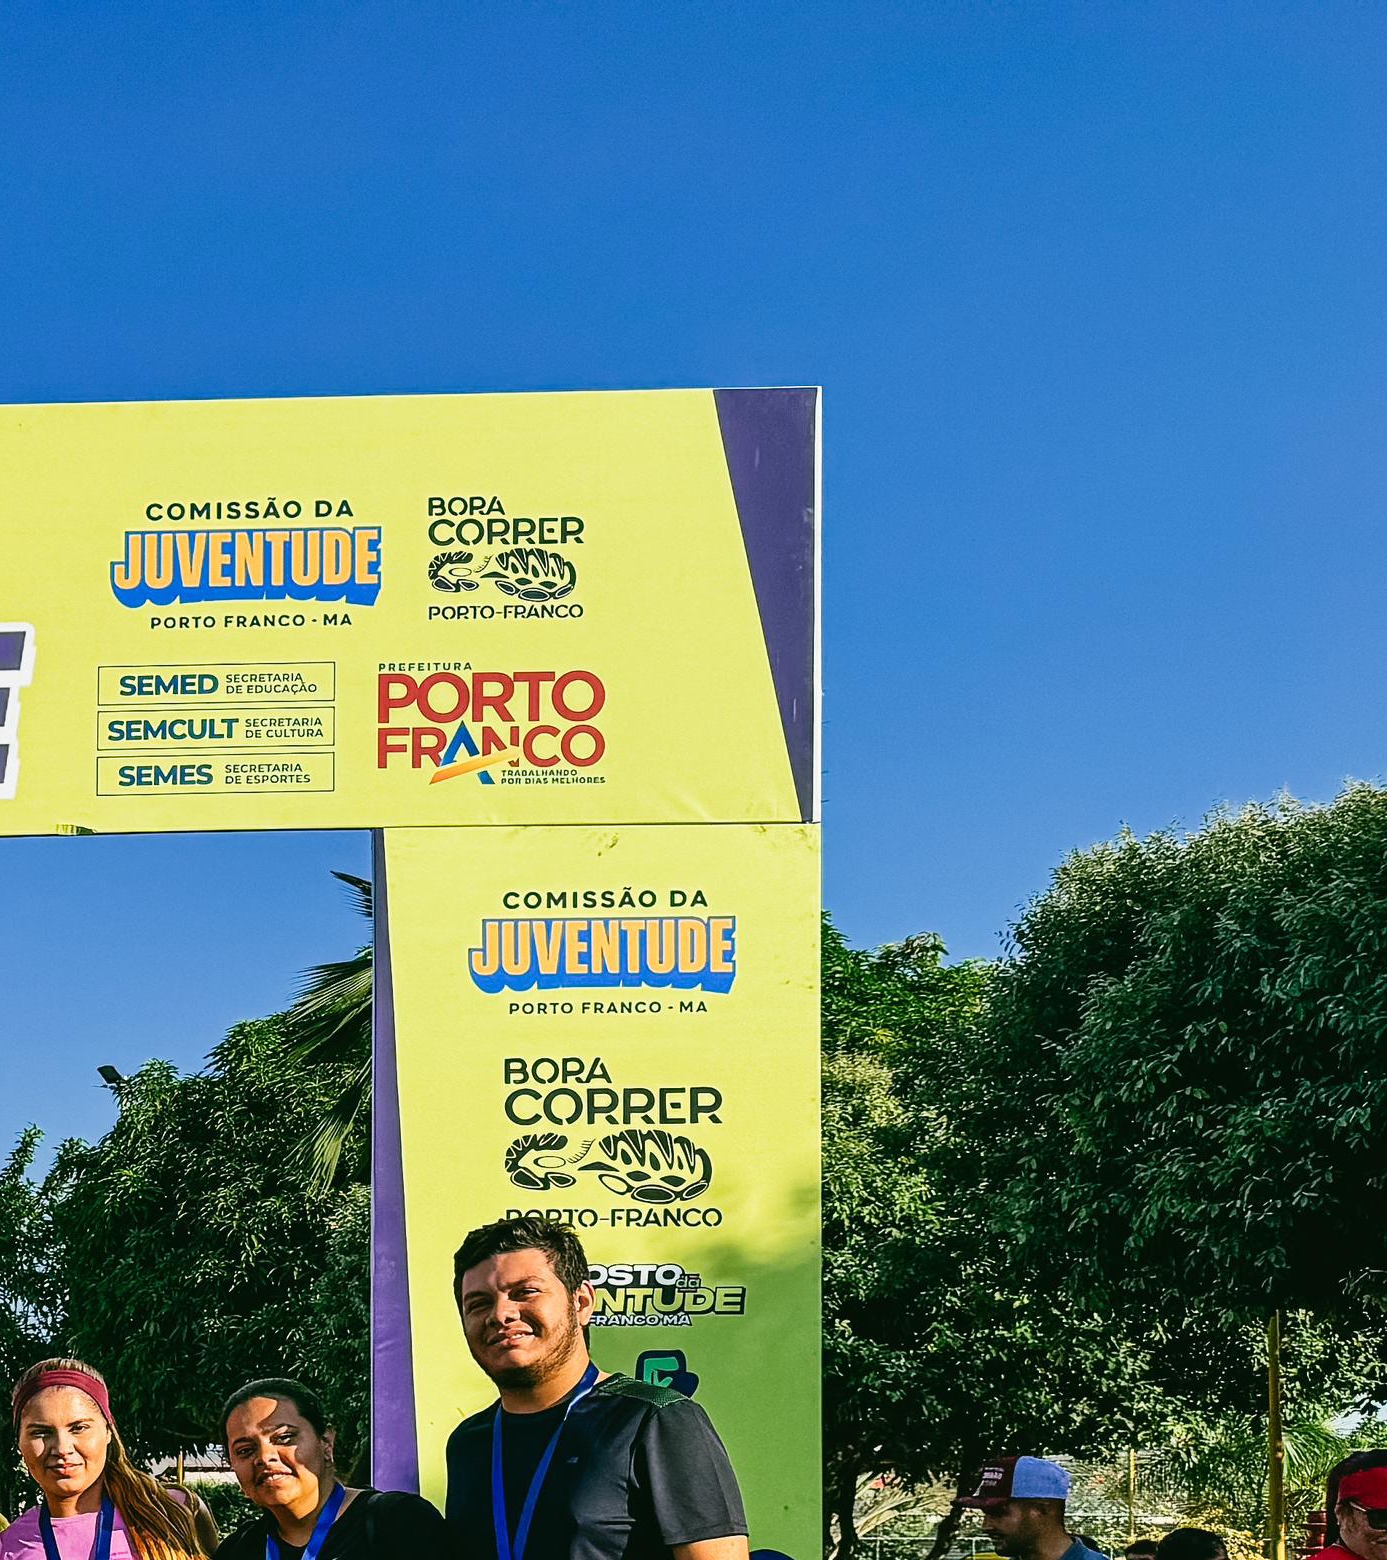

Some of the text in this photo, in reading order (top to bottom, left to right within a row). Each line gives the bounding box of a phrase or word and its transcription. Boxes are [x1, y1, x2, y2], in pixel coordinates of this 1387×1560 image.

[145, 497, 354, 521] COMISSÃO DA
[428, 496, 505, 517] BORA
[428, 517, 585, 546] CORRER
[111, 527, 382, 602] JUVENTUDE
[150, 615, 216, 629] PORTO
[224, 614, 306, 629] FRANCO
[323, 613, 353, 627] MA
[428, 604, 585, 621] PORTO-FRANCO
[378, 662, 473, 672] PREFEITURA
[119, 674, 219, 696] SEMED
[225, 672, 304, 684] SECRETARIA
[225, 680, 318, 696] DE EDUCAÇÃO
[378, 670, 606, 724] PORTO
[108, 718, 240, 742] SEMCULT
[244, 717, 323, 728] SECRETARIA
[245, 727, 324, 739] DE CULTURA
[378, 722, 606, 777] FRANCO
[118, 764, 214, 787] SEMES
[224, 763, 303, 774] SECRETARIA
[225, 773, 311, 785] DE ESPORTES
[501, 769, 579, 778] TRABALHANDO
[501, 776, 606, 785] POR DIAS MELHORES
[503, 886, 709, 911] COMISSÃO DA
[469, 917, 735, 986] JUVENTUDE
[509, 1002, 574, 1015] PORTO
[582, 1001, 662, 1014] FRANCO
[679, 1000, 708, 1013] MA
[504, 1057, 612, 1085] BORA
[504, 1087, 723, 1125] CORRER
[588, 1264, 683, 1286] OSTO
[594, 1287, 746, 1315] NTUDE
[662, 1313, 692, 1326] MA
